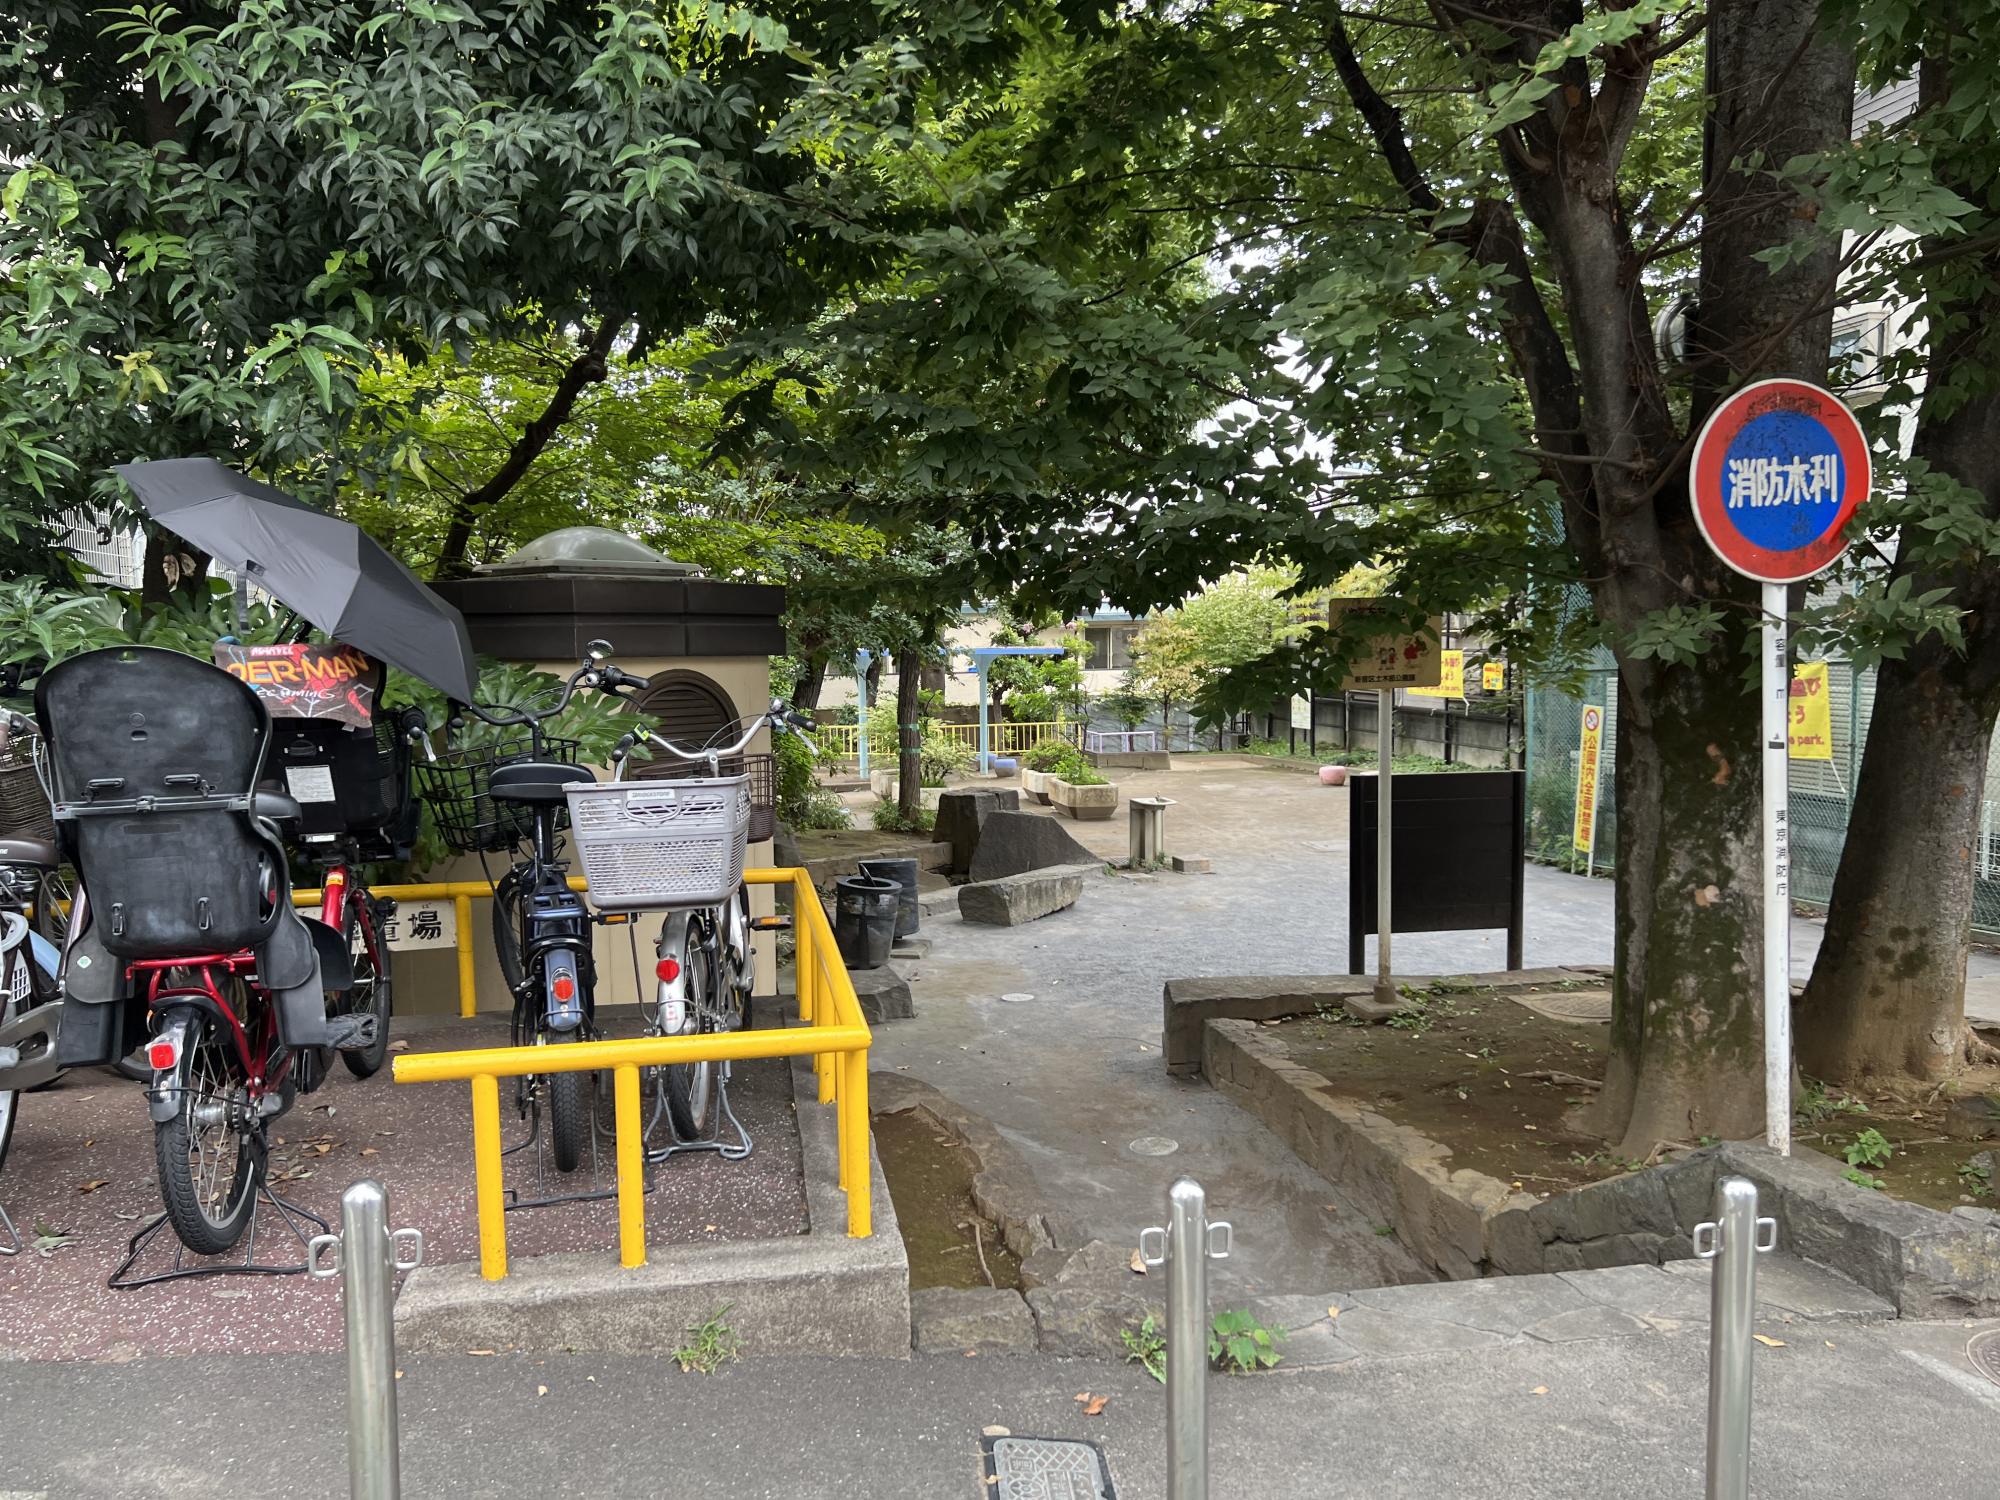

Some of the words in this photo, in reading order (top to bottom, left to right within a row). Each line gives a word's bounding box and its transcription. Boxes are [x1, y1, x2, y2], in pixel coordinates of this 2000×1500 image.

[1728, 454, 1838, 508] 消防水利
[250, 646, 295, 657] MARVEL
[1798, 734, 1825, 746] park.
[1581, 735, 1598, 841] 公園内全面禁煙
